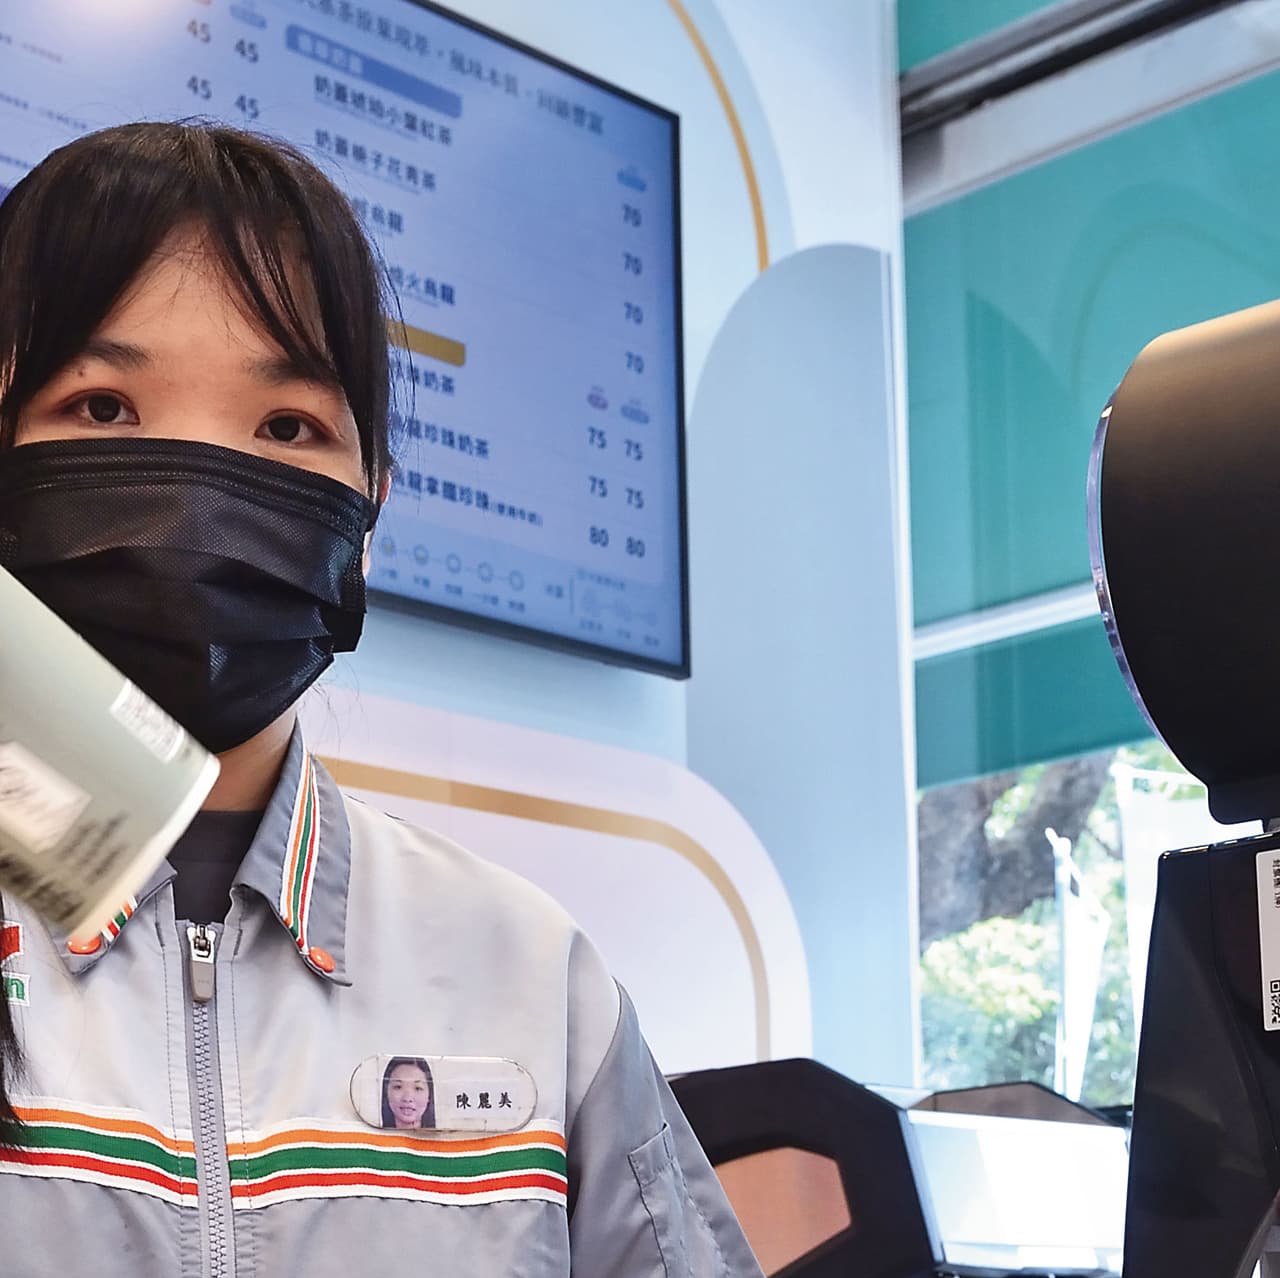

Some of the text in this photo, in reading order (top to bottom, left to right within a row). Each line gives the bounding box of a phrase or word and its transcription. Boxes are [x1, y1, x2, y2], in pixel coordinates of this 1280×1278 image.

[187, 19, 211, 44] 45
[235, 38, 259, 63] 45
[187, 75, 212, 100] 45
[235, 94, 259, 119] 45
[622, 203, 641, 228] 70
[623, 252, 642, 276] 70
[624, 302, 643, 325] 70
[625, 351, 645, 375] 70
[587, 426, 607, 450] 75
[624, 438, 643, 462] 75
[588, 475, 608, 498] 75
[626, 487, 645, 510] 75
[589, 525, 609, 547] 80
[625, 536, 645, 558] 80
[456, 1092, 513, 1110] 陳麗美
